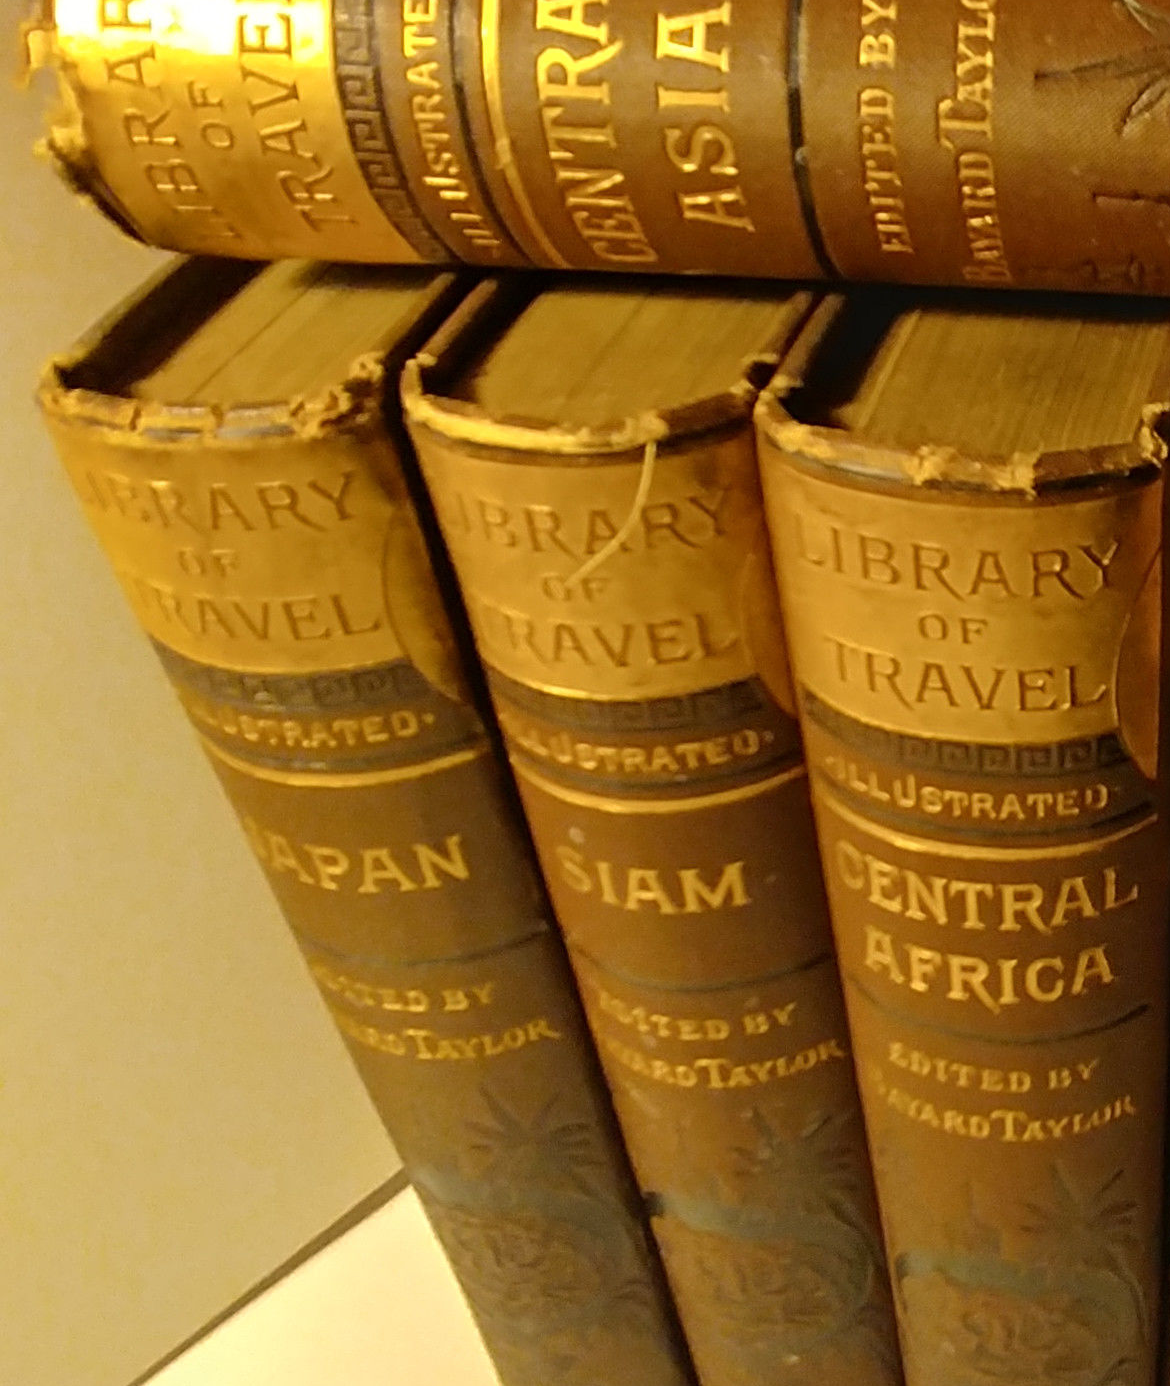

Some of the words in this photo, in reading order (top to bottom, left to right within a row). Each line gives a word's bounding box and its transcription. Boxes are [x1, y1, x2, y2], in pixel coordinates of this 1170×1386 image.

[188, 82, 236, 150] OF
[656, 0, 756, 233] ASIA
[859, 87, 914, 255] EDITED
[86, 470, 358, 531] IBRARY
[456, 489, 729, 557] IBRARY
[178, 547, 240, 577] OF
[542, 574, 611, 602] OF
[797, 517, 1120, 603] LIBRARY
[917, 614, 989, 645] OF
[825, 636, 1108, 712] TRAVEL
[555, 844, 752, 916] SIAM
[836, 839, 1140, 936] CENTRAL
[442, 980, 495, 1012] BY
[864, 925, 1116, 1015] AFRICA
[742, 1001, 798, 1036] BY
[888, 1041, 1032, 1094] EDITED
[1048, 1059, 1099, 1091] BY
